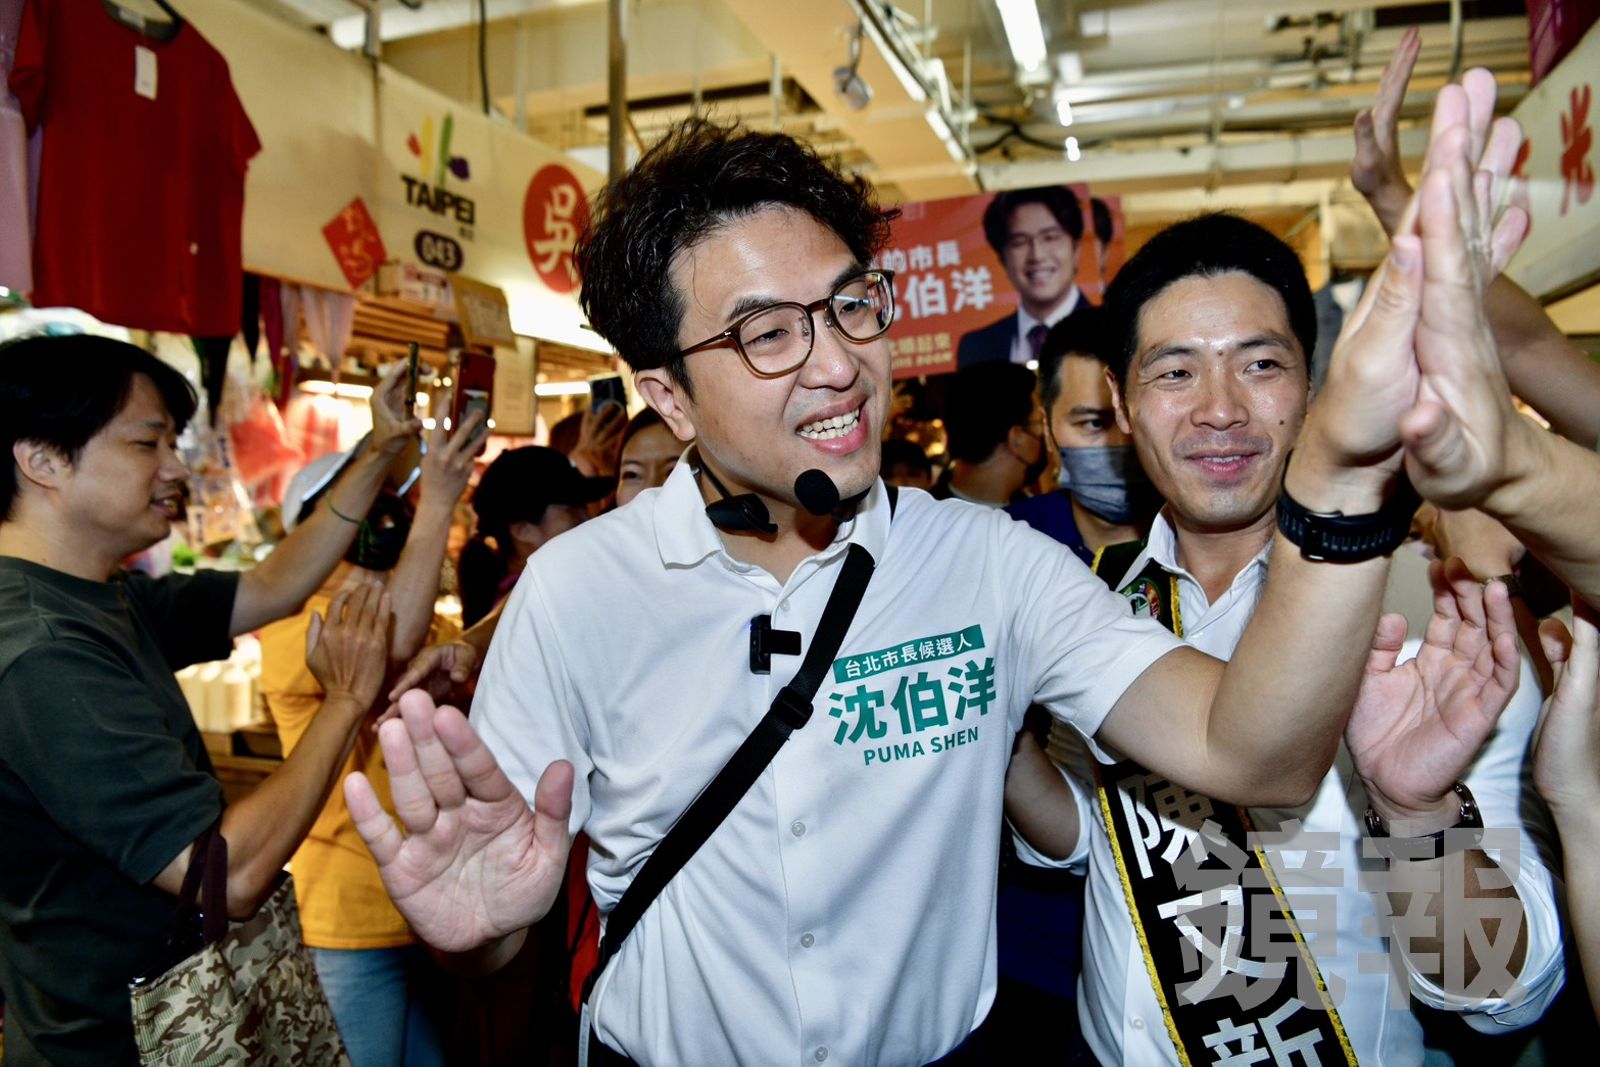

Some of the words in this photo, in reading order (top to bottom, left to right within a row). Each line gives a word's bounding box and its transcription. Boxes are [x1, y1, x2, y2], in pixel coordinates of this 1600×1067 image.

[401, 174, 475, 225] TAIPEI
[420, 233, 457, 271] 043
[533, 184, 583, 286] 吳
[892, 265, 995, 321] 伯洋
[845, 633, 972, 679] 台北市長候選人
[828, 657, 997, 746] 沈伯洋
[863, 740, 925, 766] PUMA
[930, 726, 979, 753] SHEN
